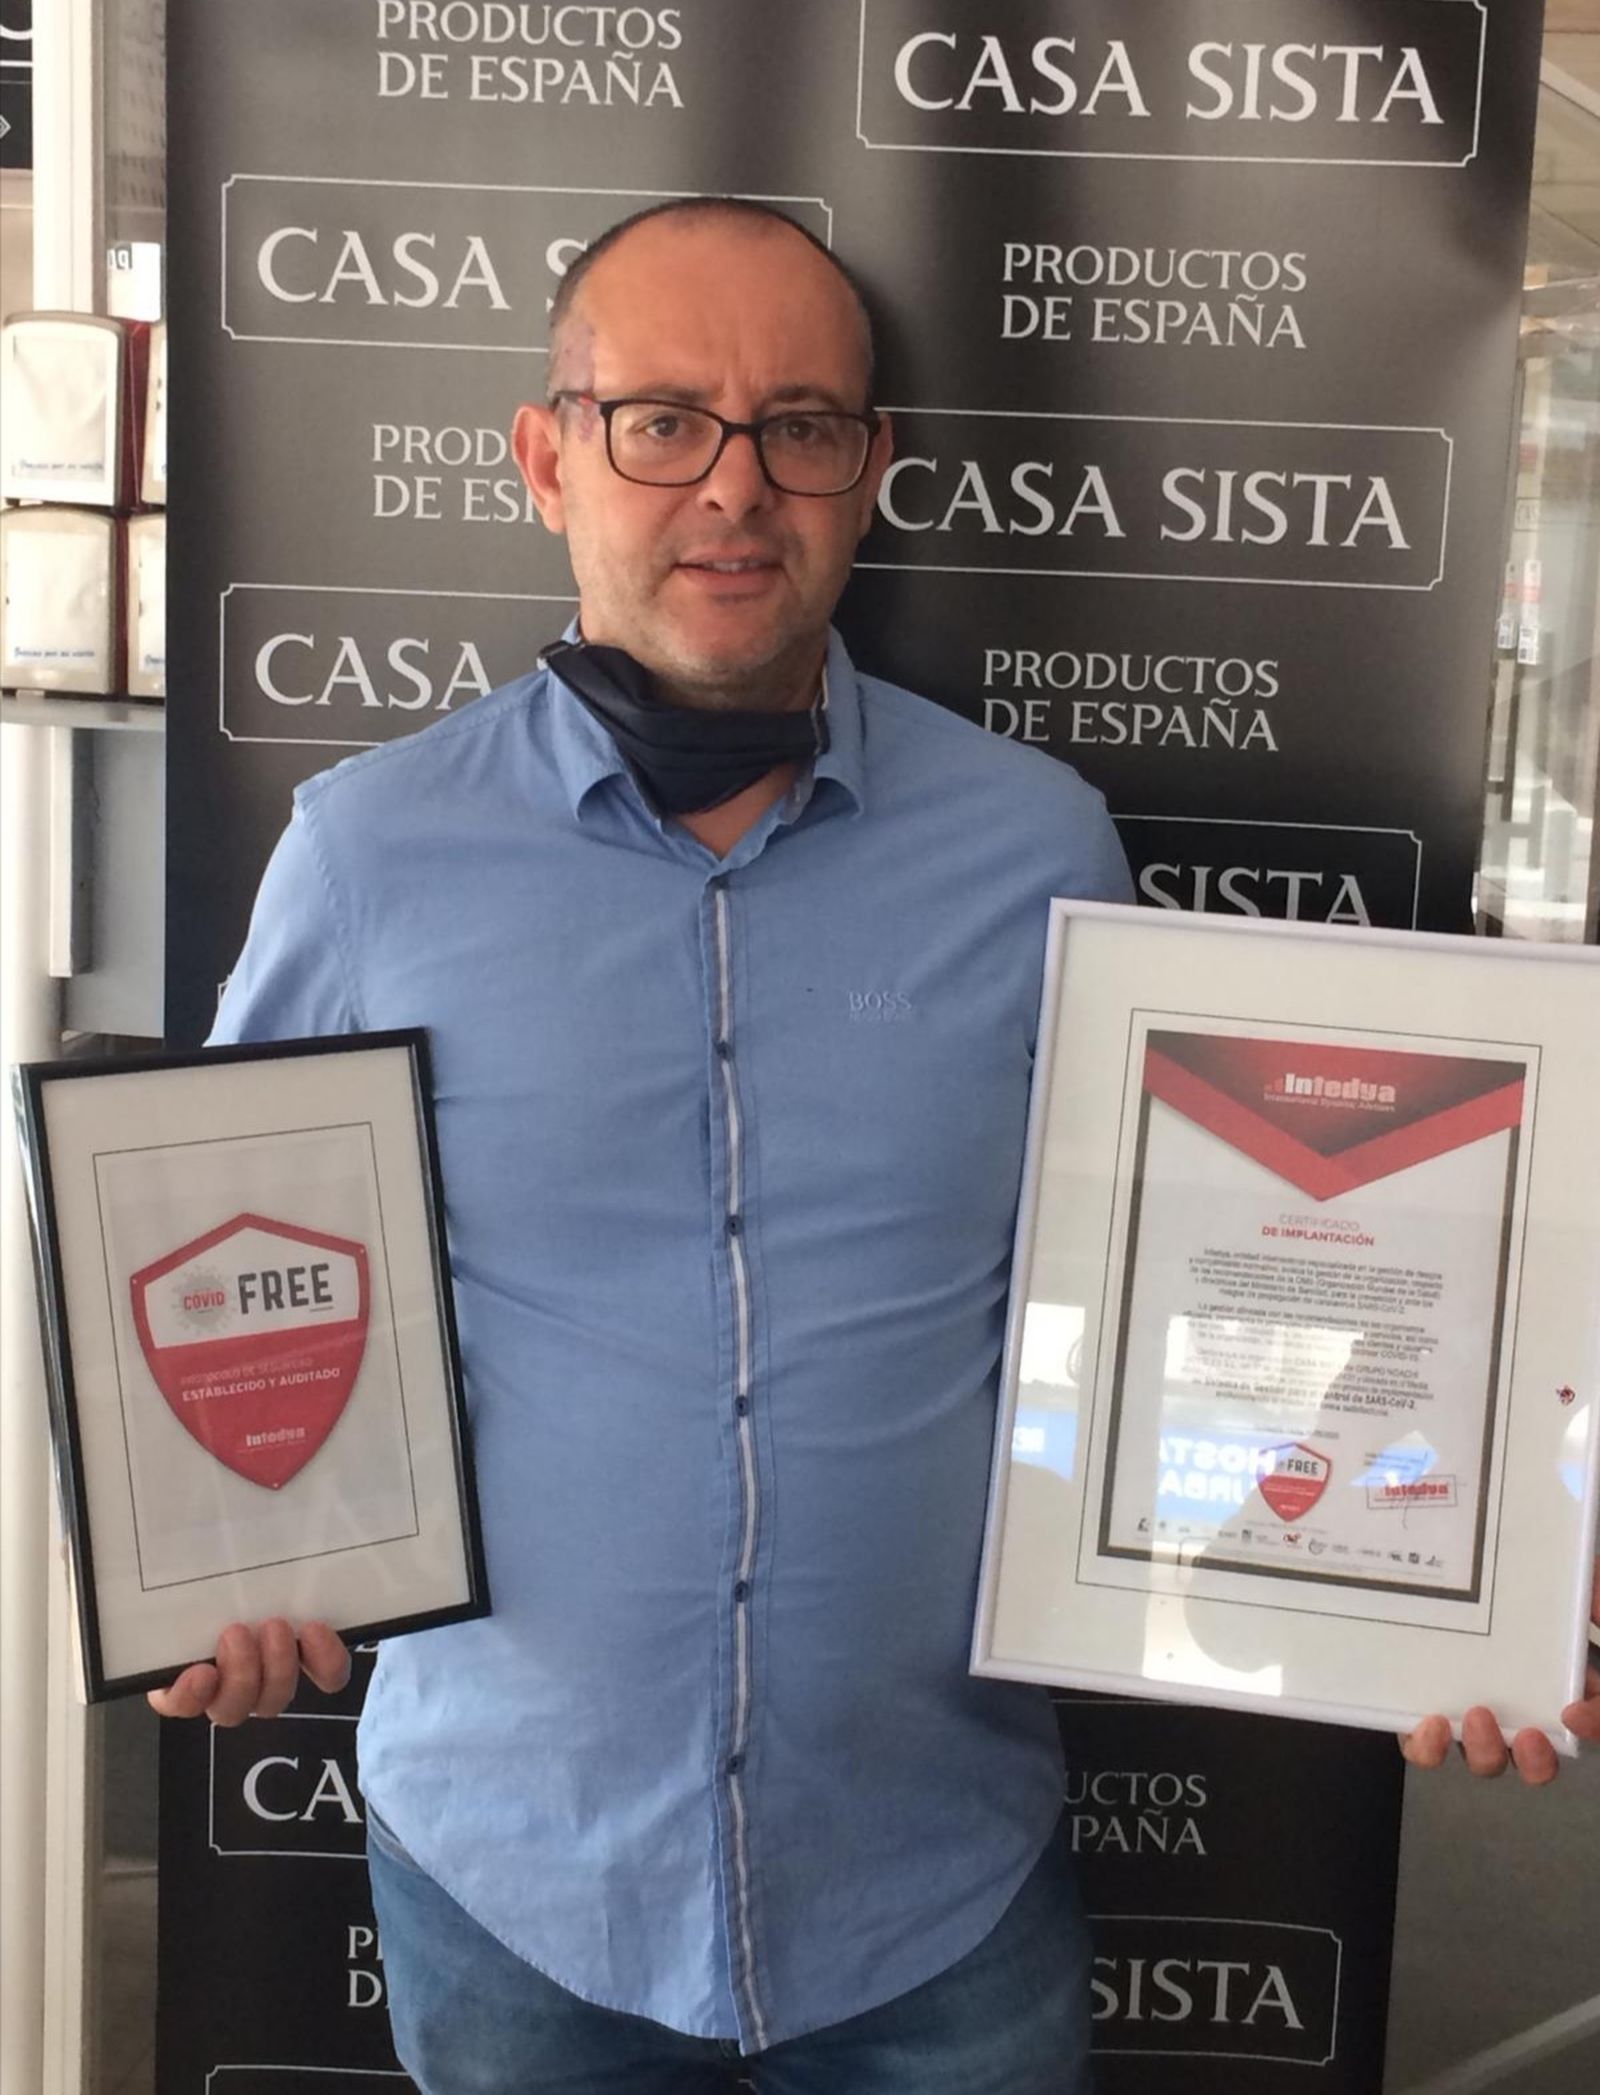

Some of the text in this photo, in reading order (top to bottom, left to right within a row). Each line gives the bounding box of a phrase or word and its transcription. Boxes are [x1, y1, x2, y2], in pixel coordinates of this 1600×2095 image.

[376, 0, 683, 50] PRODUCTOS
[377, 51, 684, 108] DE ESPAÑA
[894, 32, 1444, 125] CASA SISTA
[256, 226, 512, 311] CASA
[1003, 243, 1307, 292] PRODUCTOS
[1001, 294, 1306, 349] DE ESPAÑA
[373, 474, 442, 519] DE
[878, 456, 1411, 550] CASA SISTA
[254, 633, 492, 710] CASA
[983, 649, 1279, 698] PRODUCTOS
[983, 697, 1278, 753] DE ESPAÑA
[1138, 863, 1372, 928] SISTA
[848, 991, 912, 1011] BOSS
[1262, 1226, 1375, 1246] DE IMPLANTACIÓN
[183, 1263, 333, 1315] COVID FREE
[182, 1367, 340, 1402] ESTABLECIDO Y AUDITADO
[1287, 1458, 1319, 1476] FREE
[242, 1756, 364, 1823] CA
[1064, 1771, 1208, 1807] UCTOS
[1070, 1808, 1208, 1856] PAÑA
[347, 1969, 388, 2009] D
[1090, 1956, 1305, 2031] SISTA
